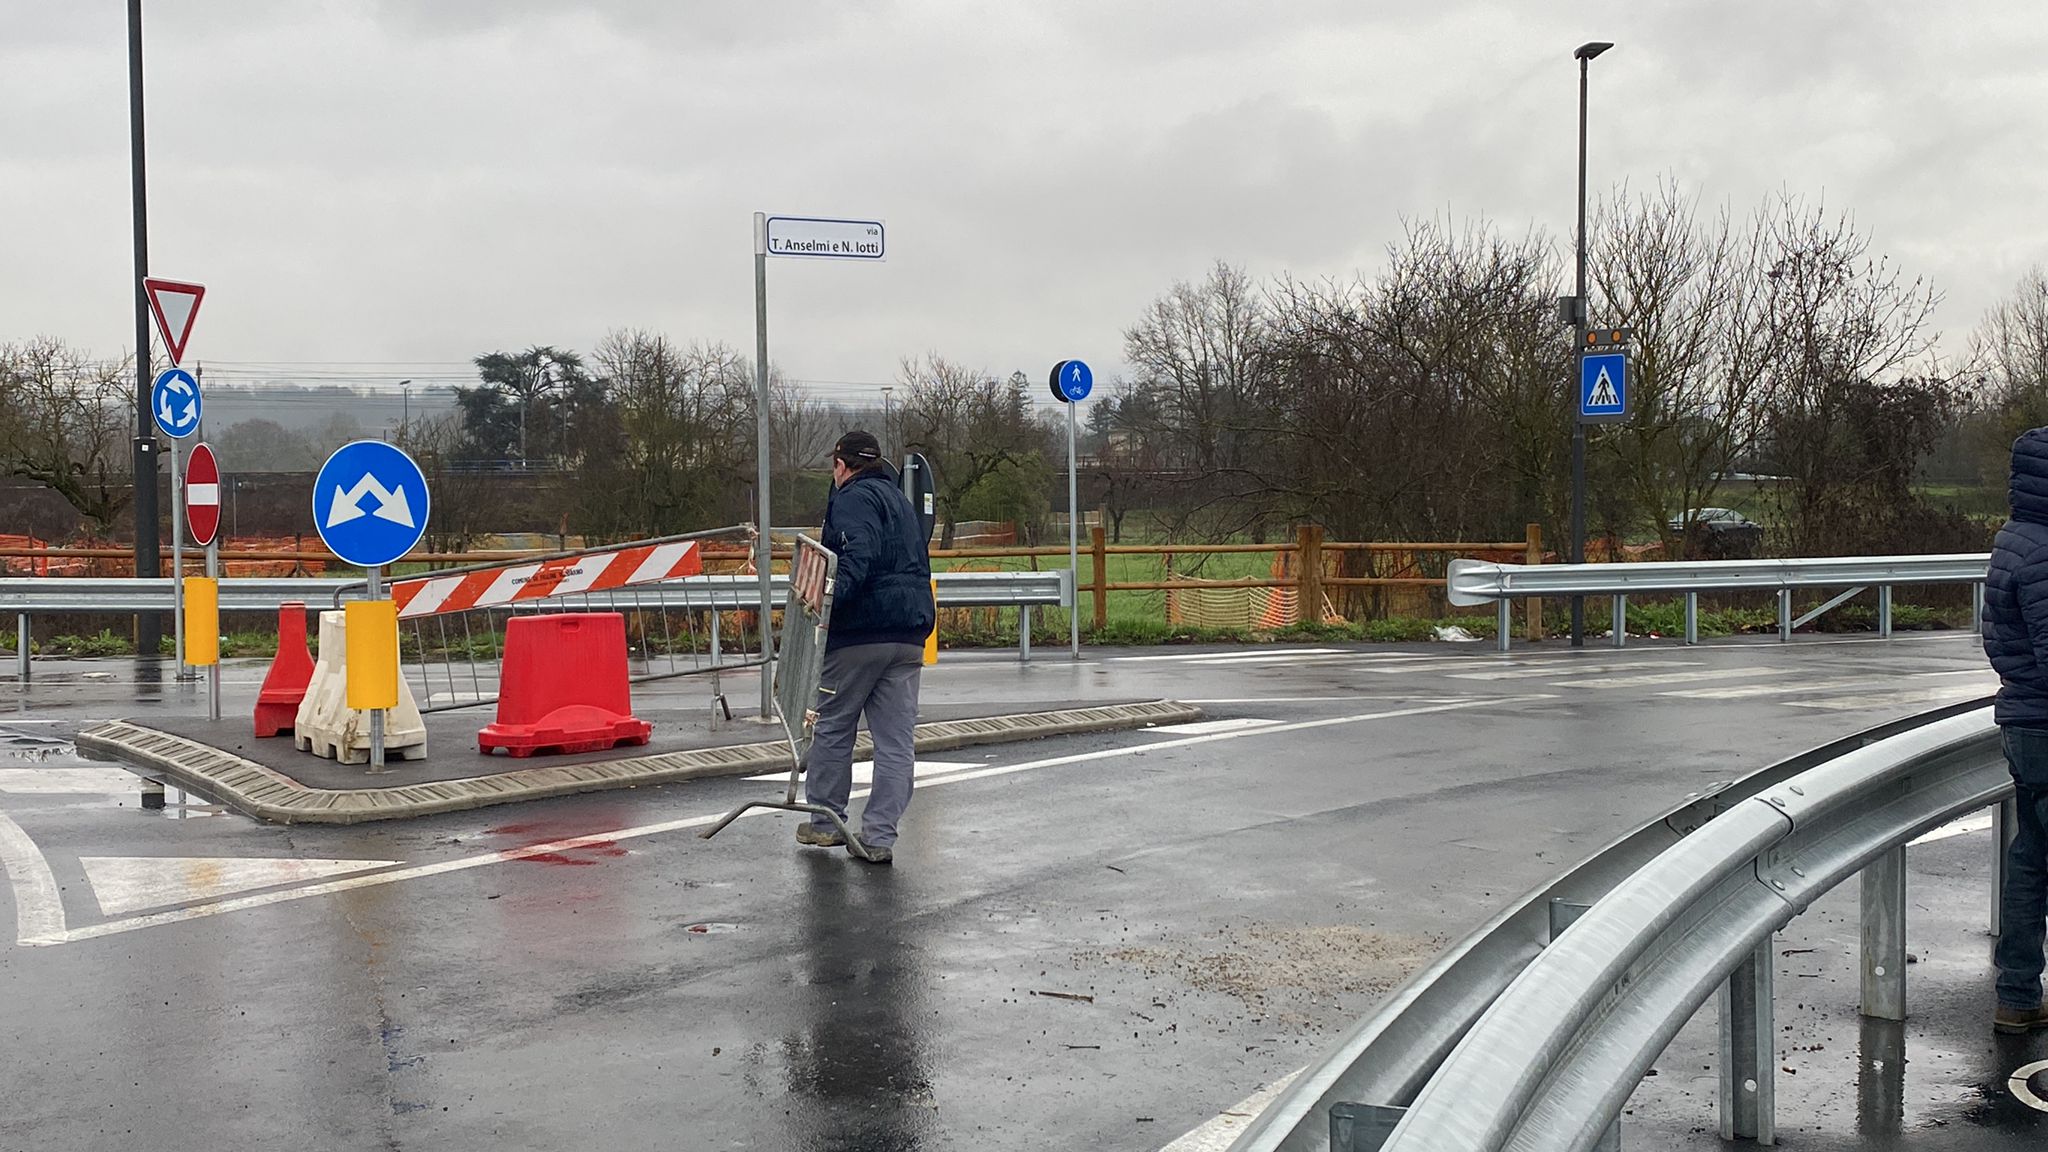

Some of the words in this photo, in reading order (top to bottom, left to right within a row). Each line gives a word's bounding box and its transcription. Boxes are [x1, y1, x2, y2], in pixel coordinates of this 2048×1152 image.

[866, 227, 879, 236] via
[772, 238, 783, 250] T.
[785, 239, 830, 252] Anselmi
[832, 243, 839, 252] e
[841, 241, 853, 253] N.
[856, 241, 879, 254] Iotti
